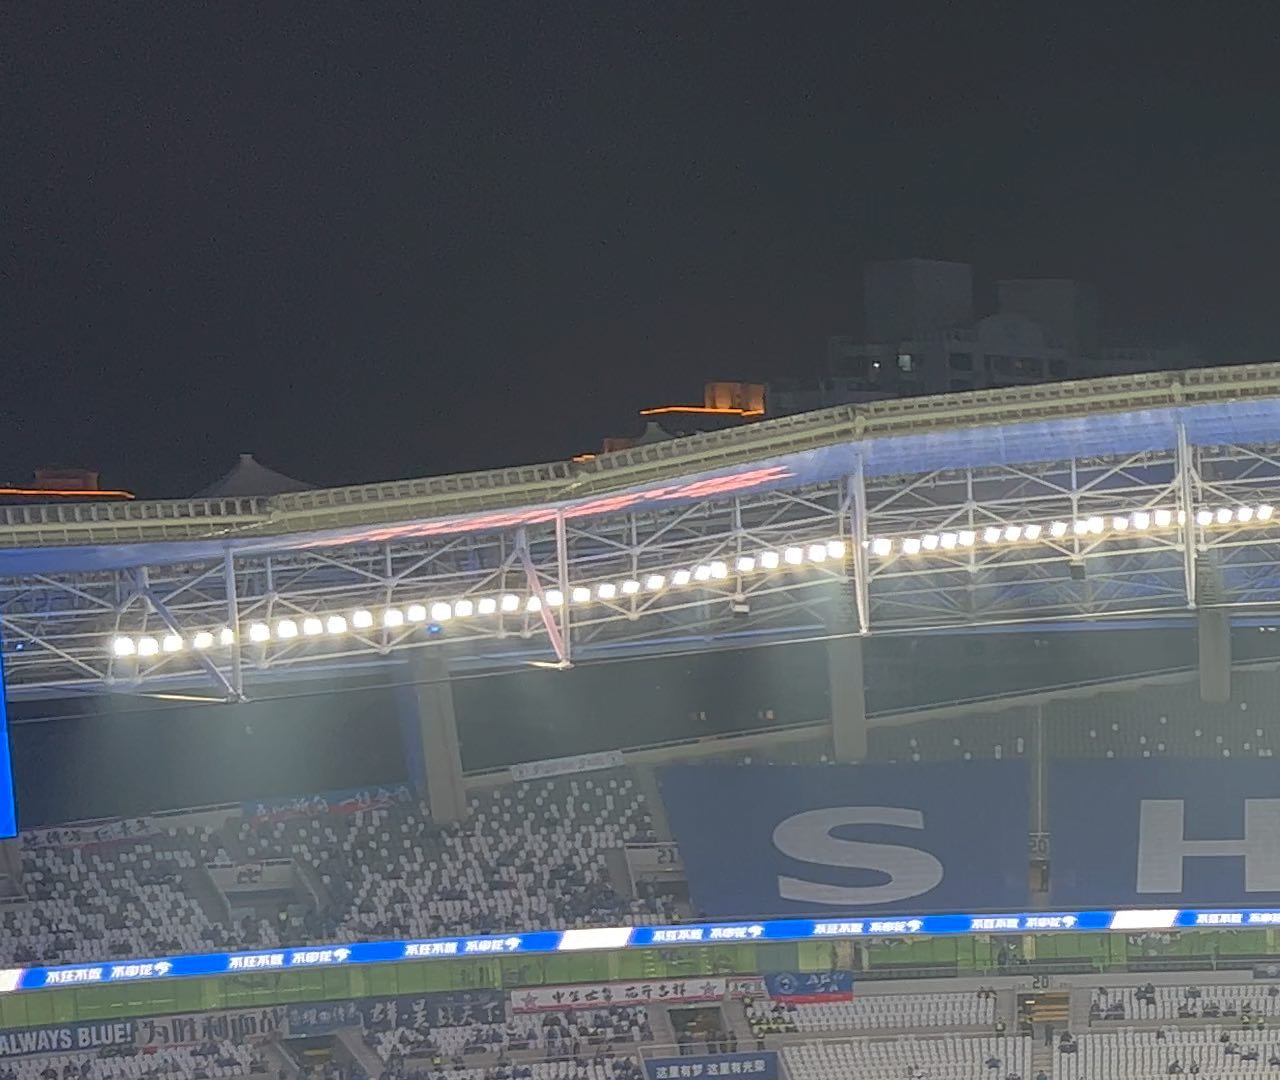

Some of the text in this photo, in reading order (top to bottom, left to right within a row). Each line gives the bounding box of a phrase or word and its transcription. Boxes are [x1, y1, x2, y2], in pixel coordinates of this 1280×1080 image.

[1033, 976, 1049, 990] 20
[0, 1022, 132, 1056] ALWAYS BLUE!
[656, 1063, 704, 1079] 这里有梦
